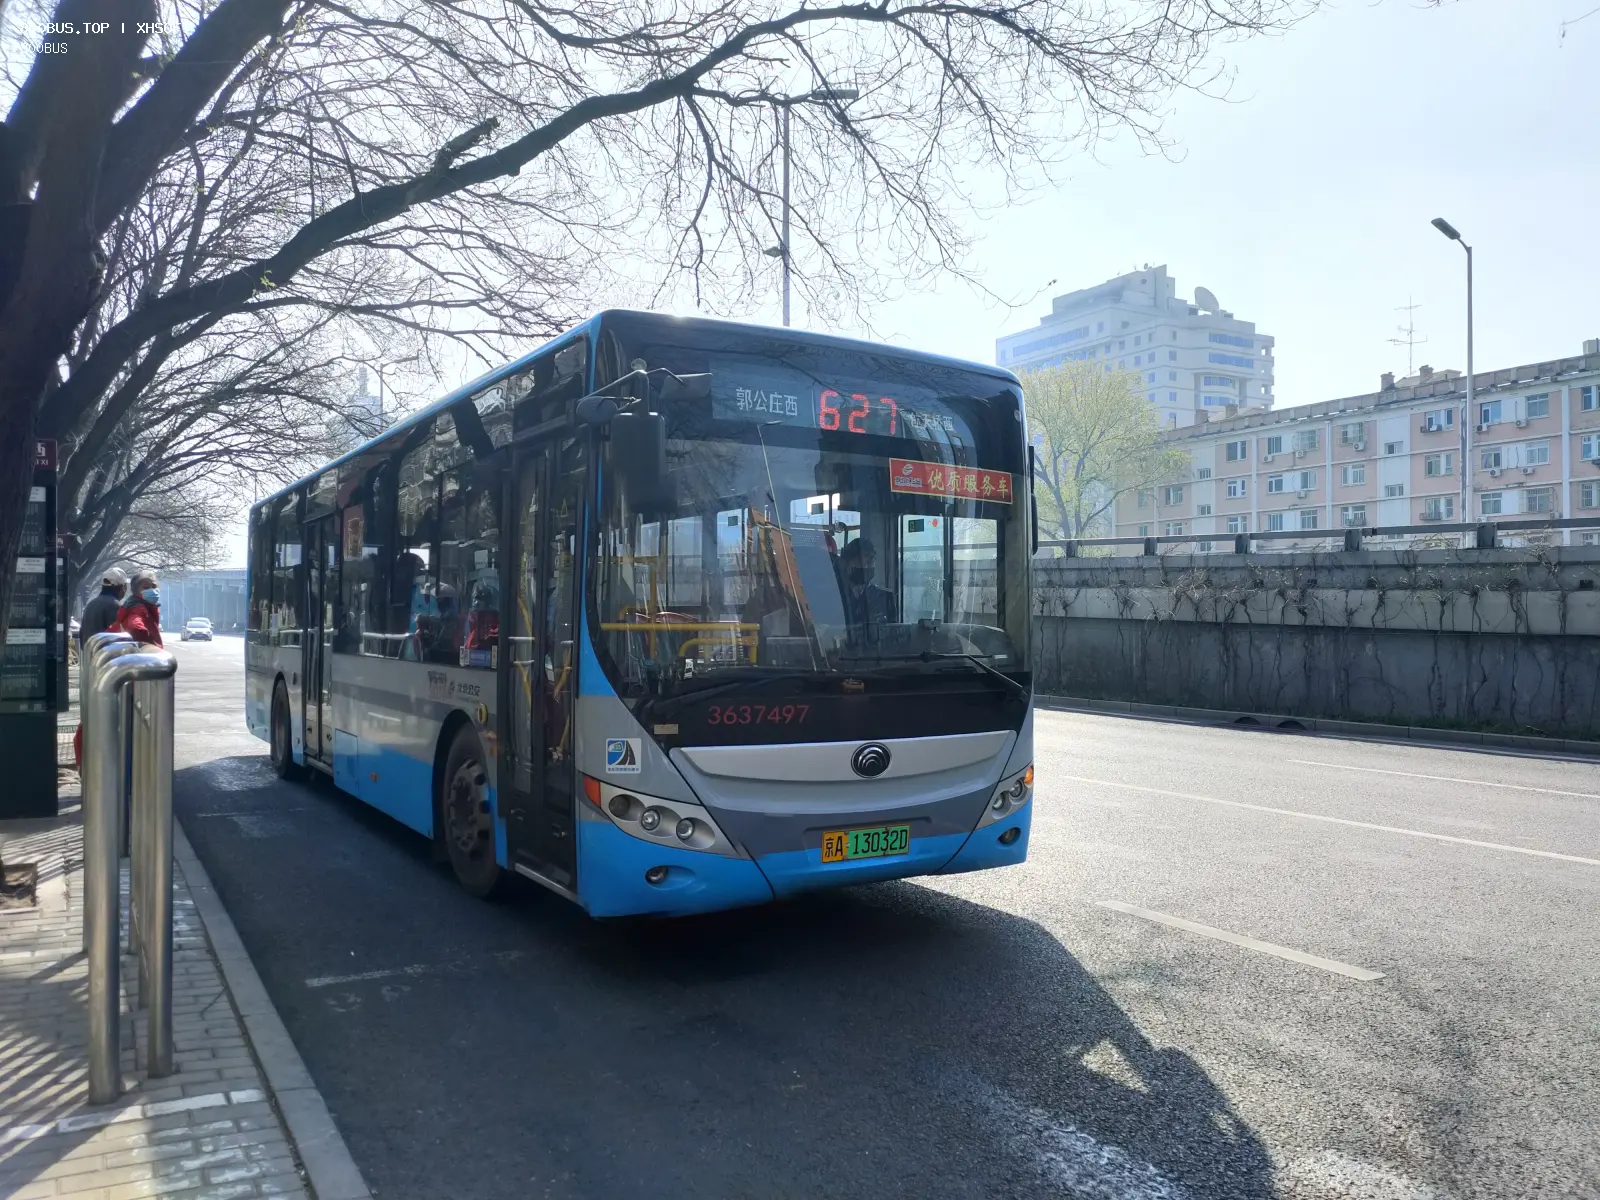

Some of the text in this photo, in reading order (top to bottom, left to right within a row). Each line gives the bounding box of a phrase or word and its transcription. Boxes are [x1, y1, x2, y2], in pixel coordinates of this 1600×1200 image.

[736, 386, 799, 417] 郭公庄西
[819, 389, 898, 436] 627
[927, 468, 1009, 499] 优质服务车
[707, 704, 810, 725] 3637497
